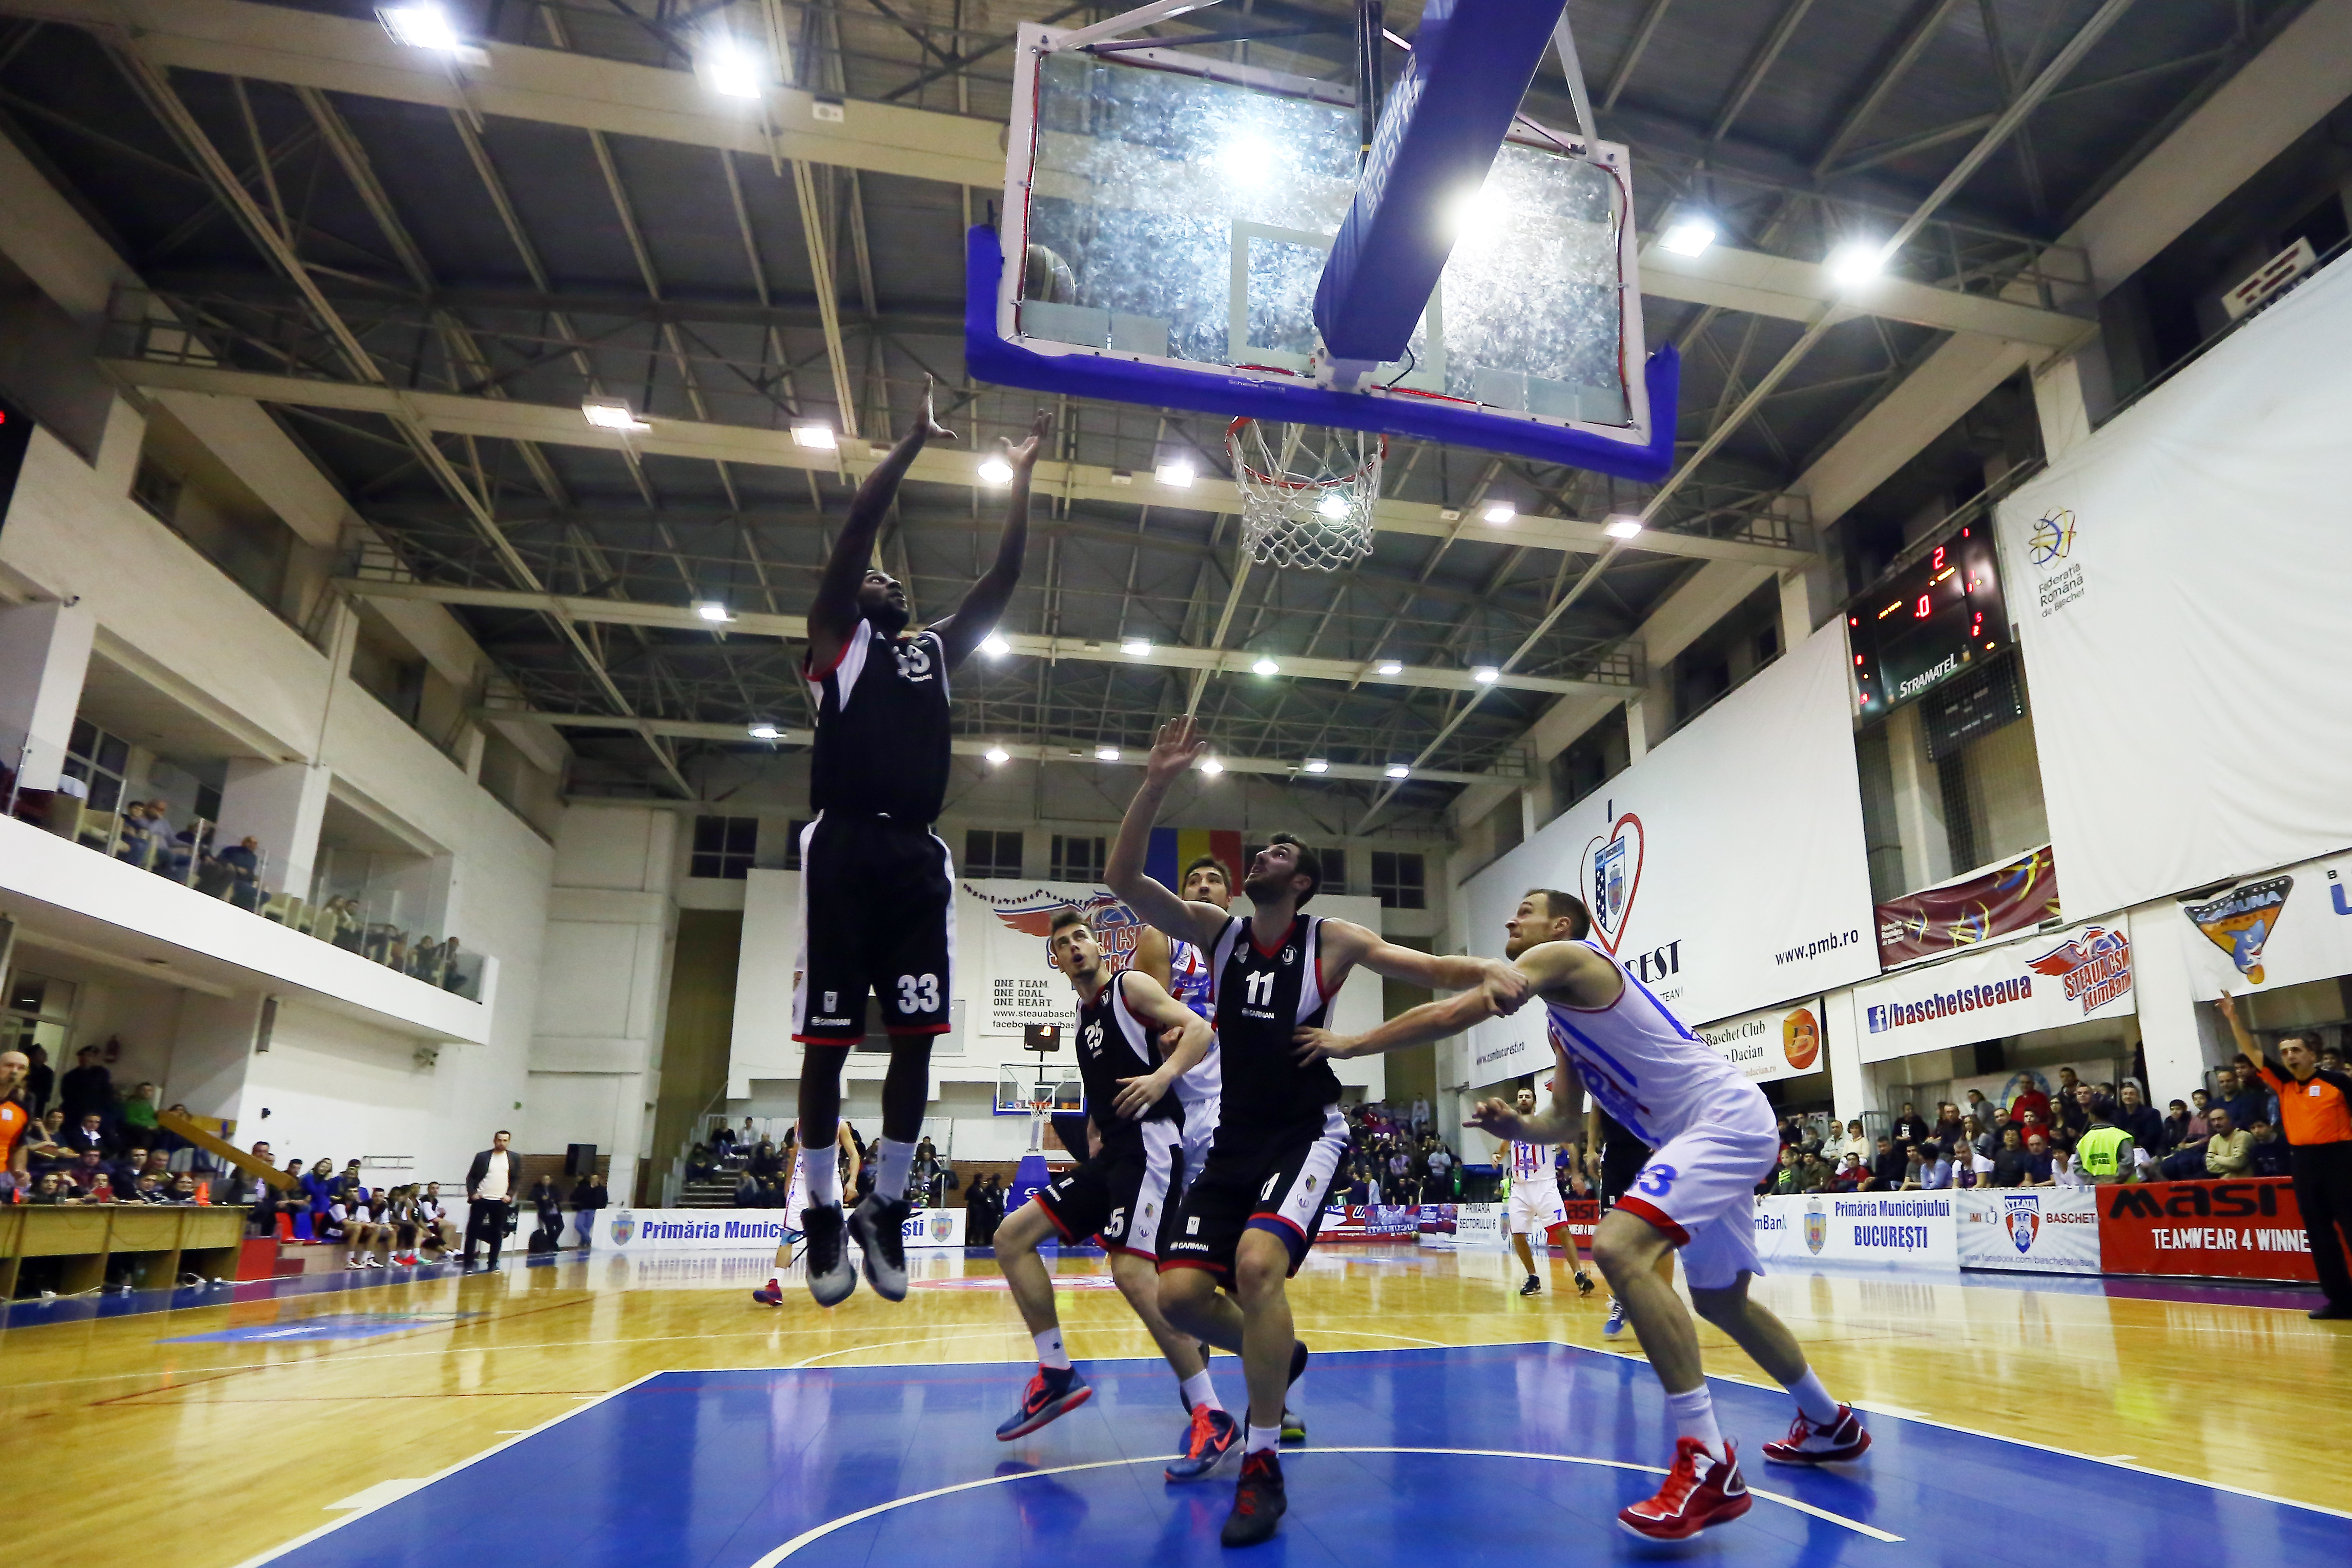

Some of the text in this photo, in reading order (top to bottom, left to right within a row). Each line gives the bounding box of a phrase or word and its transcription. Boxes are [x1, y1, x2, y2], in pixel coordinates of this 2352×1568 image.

[1933, 547, 1945, 569] 2
[1775, 930, 1859, 966] www.pmb.ro
[994, 979, 1014, 987] ONE
[1246, 969, 1275, 1006] 11
[898, 973, 940, 1014] 33
[994, 989, 1014, 997] ONE
[994, 998, 1014, 1006] ONE
[993, 1010, 1075, 1018] www.steauabasch
[1084, 1019, 1104, 1050] 25
[1742, 1019, 1766, 1038] Club
[1731, 1045, 1764, 1063] Dacian
[1639, 1164, 1679, 1198] 3
[1553, 1208, 1562, 1221] 7
[1880, 1199, 1950, 1219] Municipiului
[2046, 1212, 2096, 1224] BASCHET
[642, 1220, 924, 1240] Primăria Munic ști
[1754, 1214, 1787, 1230] mBank
[1178, 1241, 1209, 1252] GARMAN
[2152, 1228, 2312, 1252] TEAMWEAR 4 WINNE
